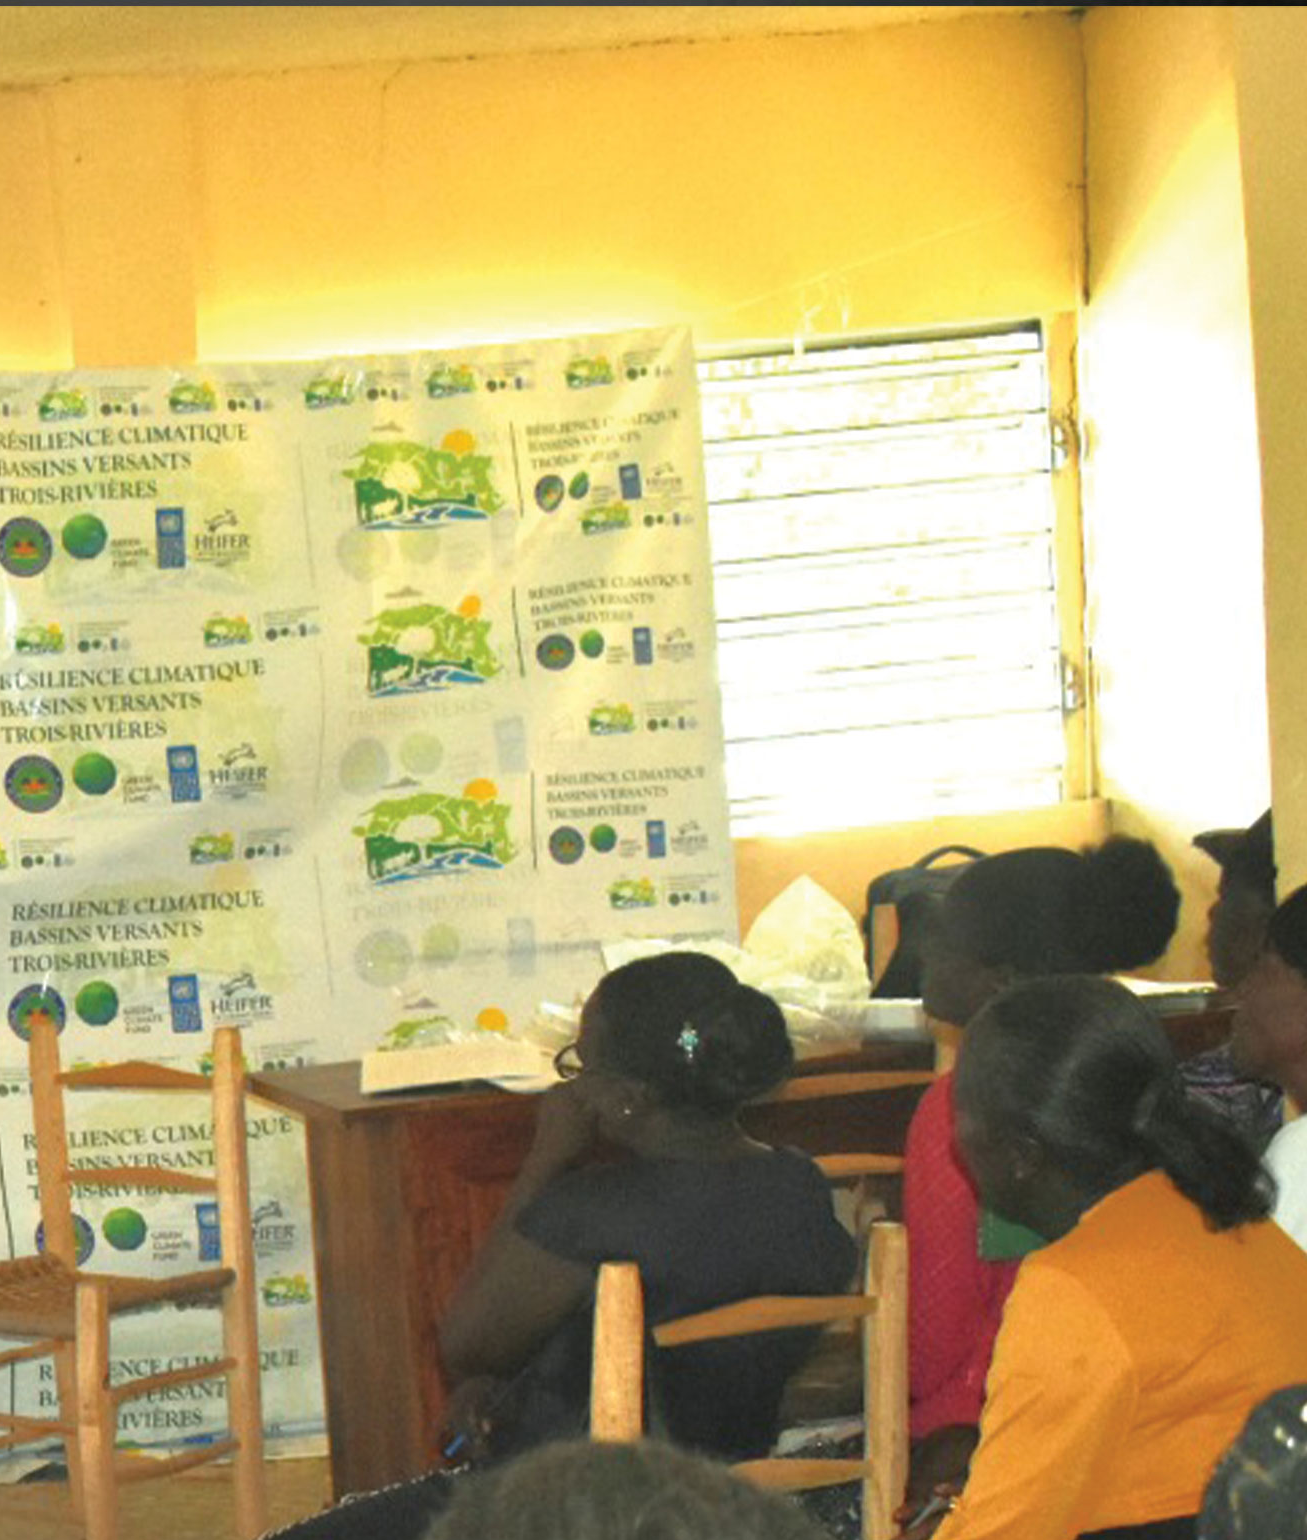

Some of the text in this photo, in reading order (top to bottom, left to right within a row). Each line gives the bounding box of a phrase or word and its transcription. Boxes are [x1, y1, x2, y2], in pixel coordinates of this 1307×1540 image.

[118, 423, 249, 445] CLIMATIQUE
[81, 452, 192, 475] VERSANTS
[128, 658, 266, 686] CLIMATIQUE
[92, 691, 203, 714] VERSANTS
[0, 720, 168, 746] TROIS-RIVIÈRES
[11, 889, 265, 923] RÉSILIENCE CLIMATIQUE
[9, 920, 203, 948] BASSINS VERSANTS
[7, 948, 170, 974] TROIS-RIVIÈRES
[210, 995, 273, 1015] HEIFER
